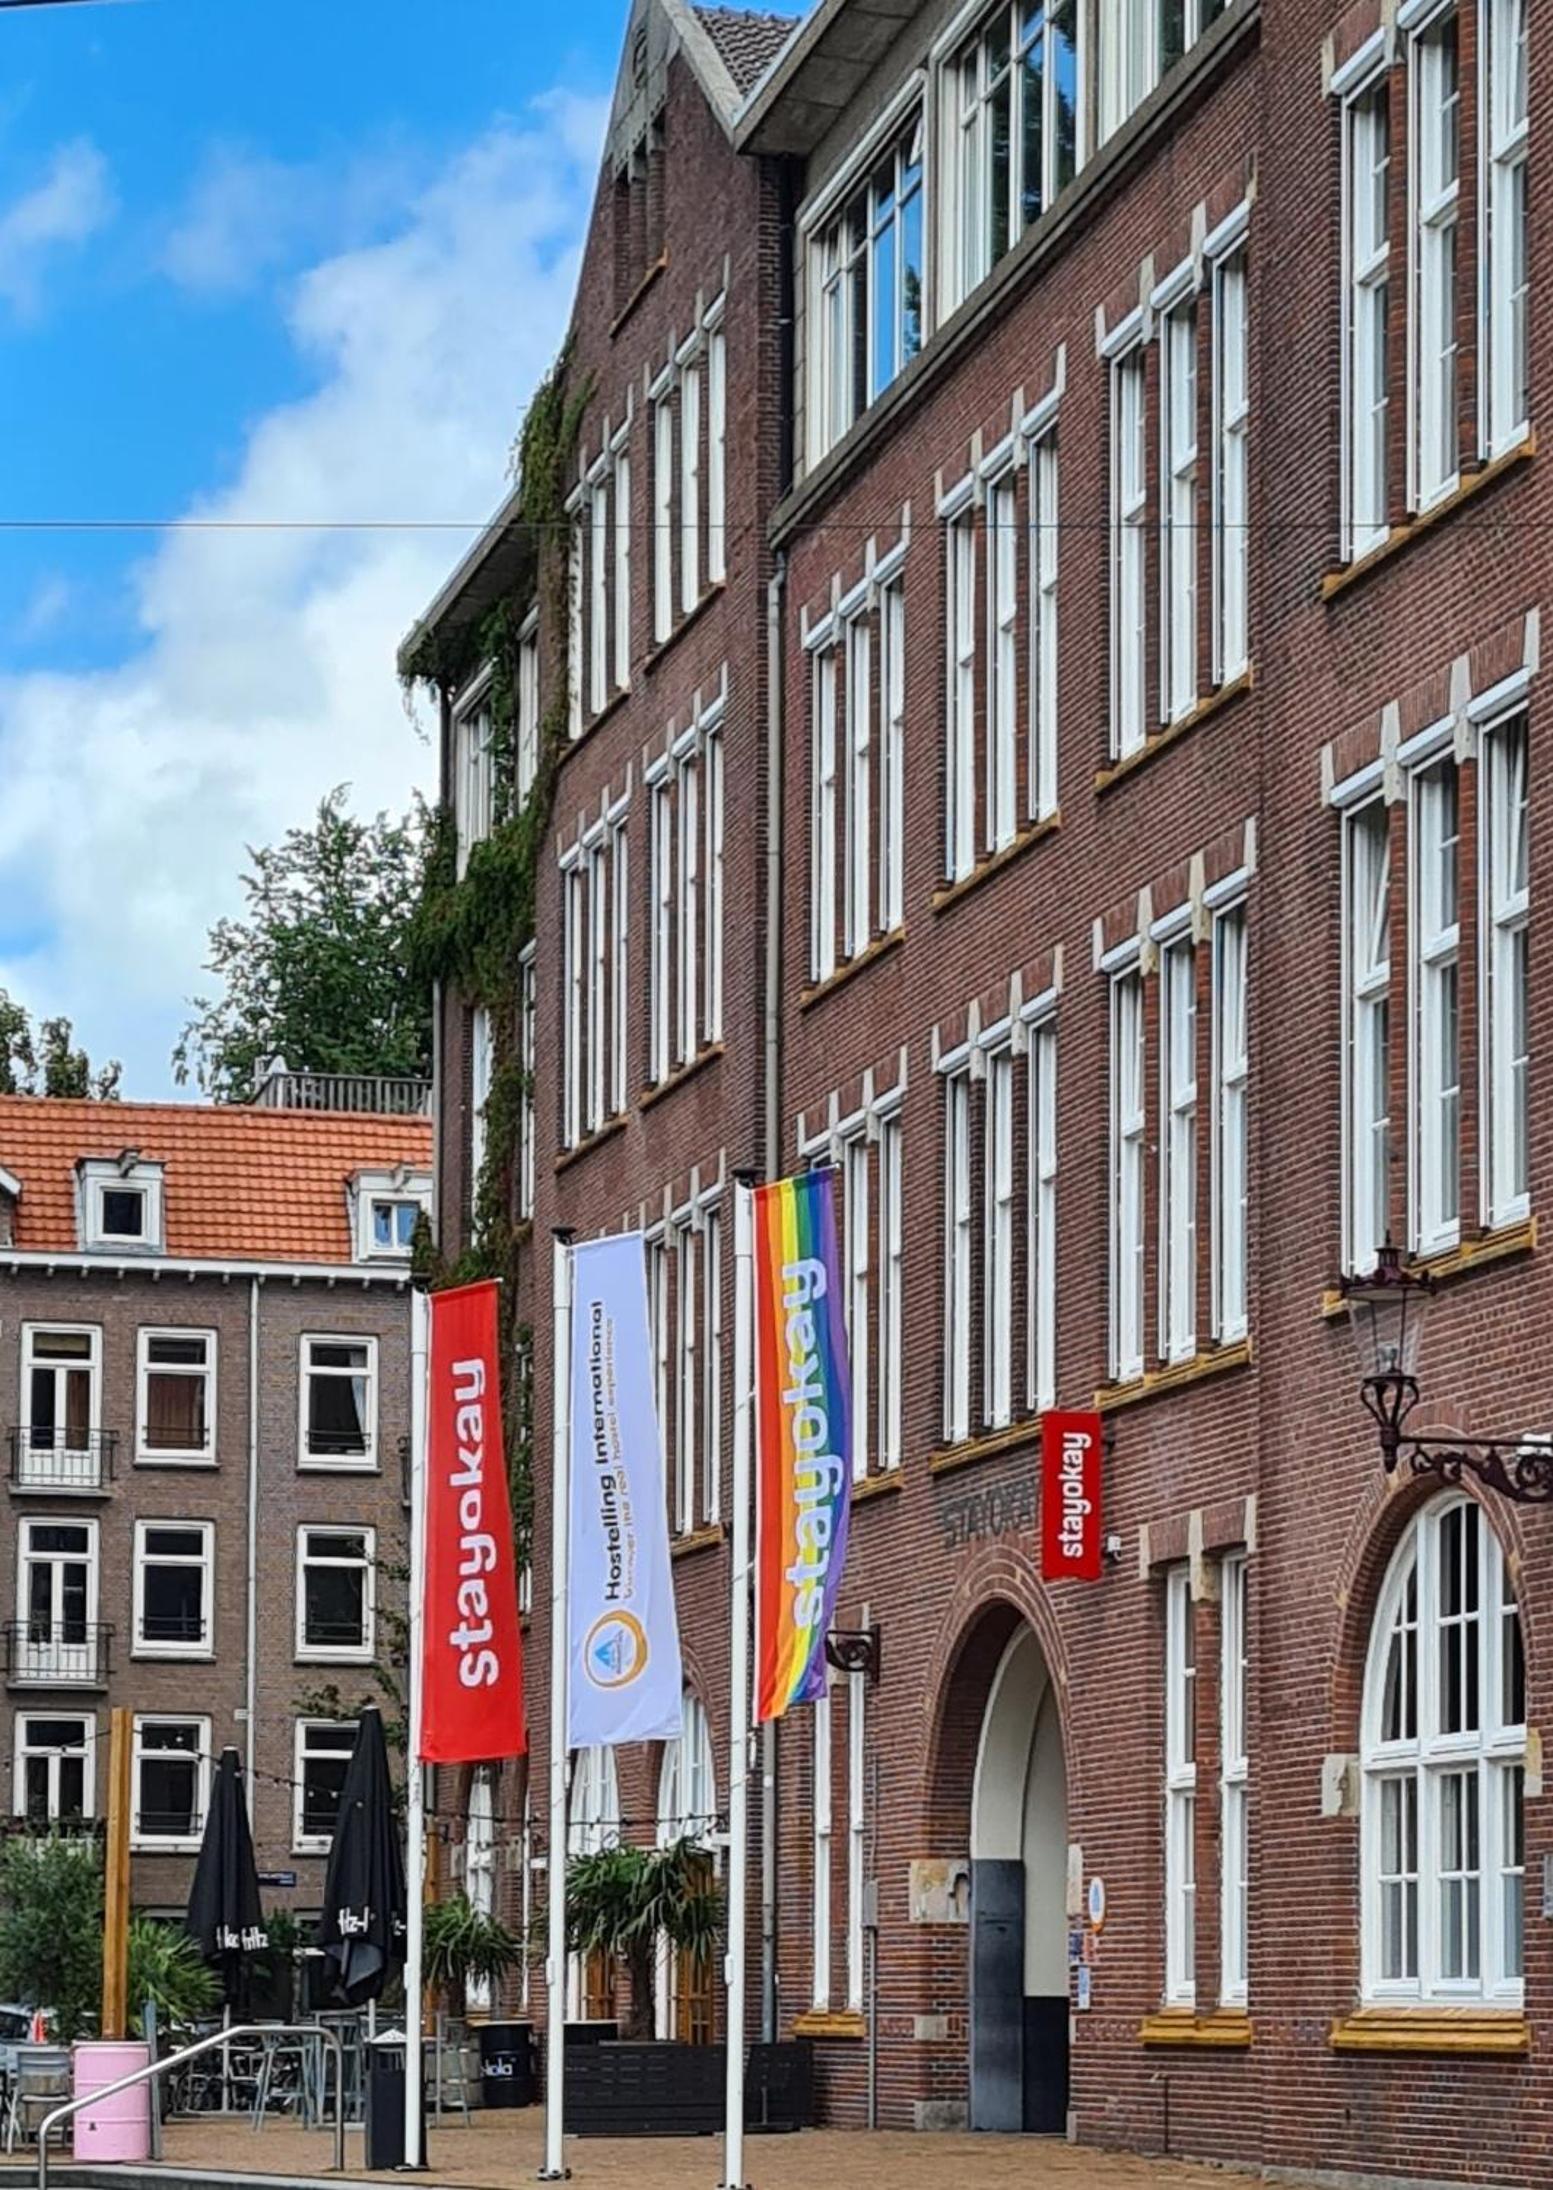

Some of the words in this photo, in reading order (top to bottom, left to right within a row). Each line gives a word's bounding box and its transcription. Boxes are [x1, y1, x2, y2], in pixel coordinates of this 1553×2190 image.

[590, 1301, 608, 1465] International
[782, 1256, 842, 1631] stayokay
[450, 1358, 498, 1688] stayokay
[600, 1475, 621, 1600] Hostelling
[1057, 1432, 1092, 1559] stayokay
